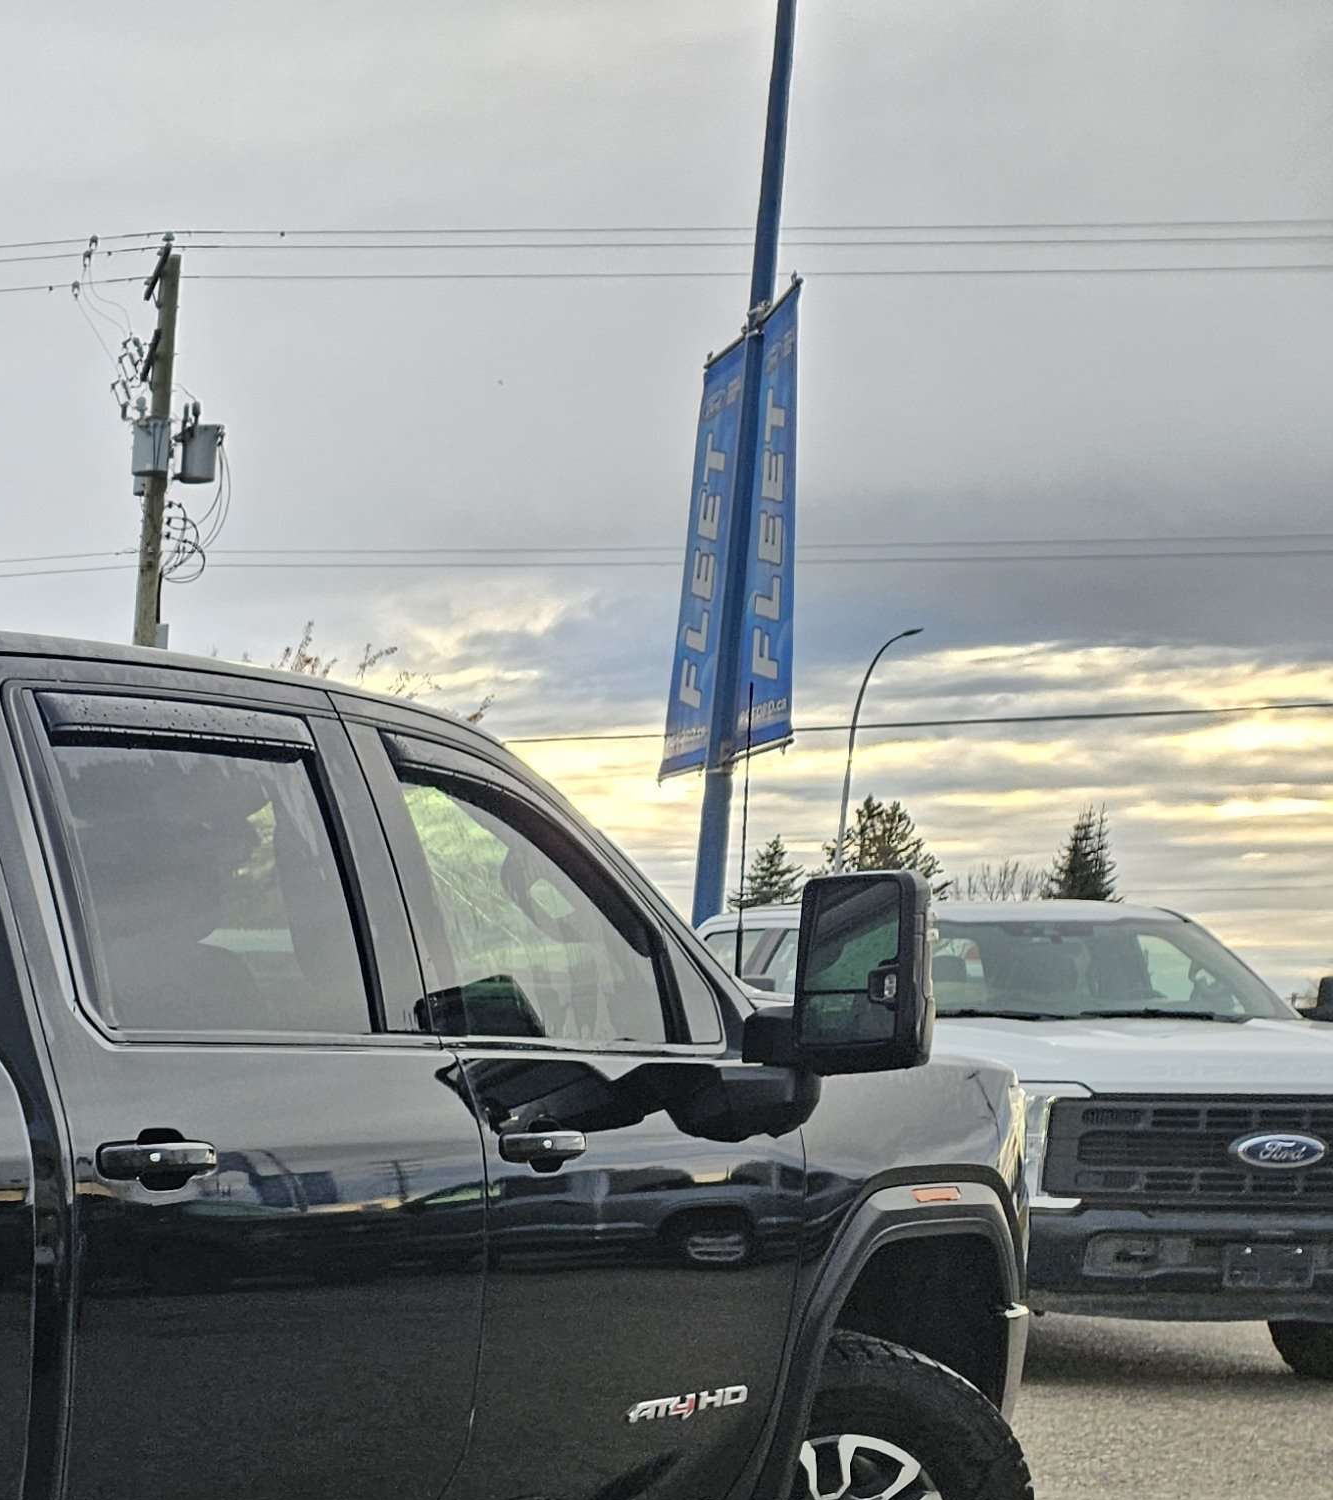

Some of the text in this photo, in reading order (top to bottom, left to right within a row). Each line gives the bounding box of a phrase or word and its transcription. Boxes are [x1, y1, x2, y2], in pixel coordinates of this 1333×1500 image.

[678, 431, 726, 709] FLEET
[750, 388, 786, 681] FLEET
[1259, 1140, 1307, 1161] Ford
[628, 1384, 748, 1423] AT4 HD
